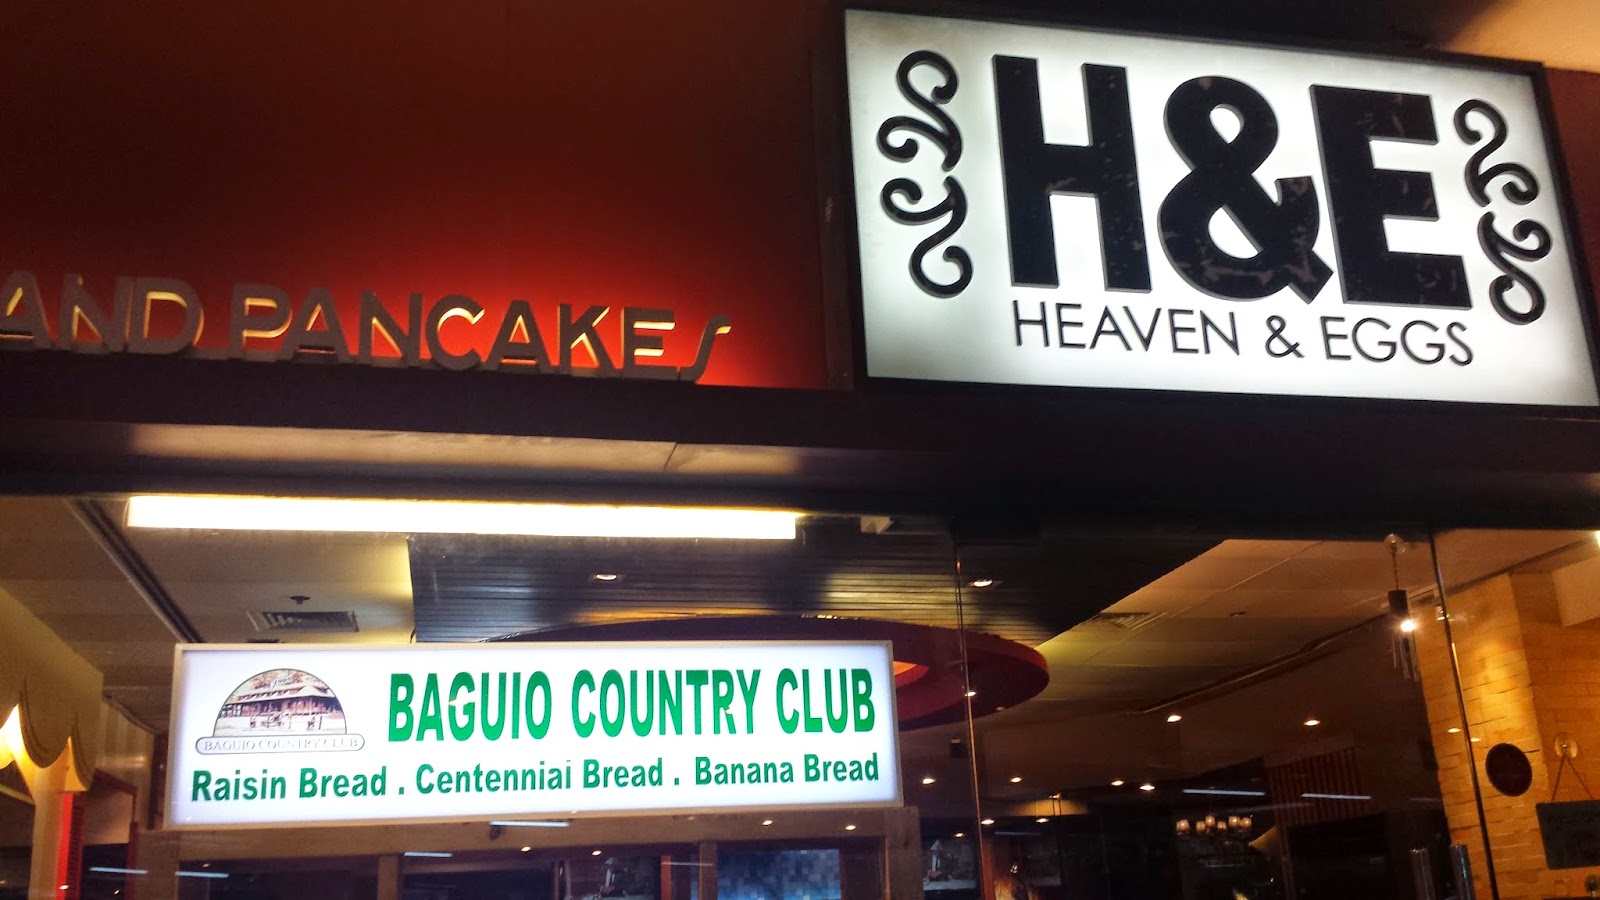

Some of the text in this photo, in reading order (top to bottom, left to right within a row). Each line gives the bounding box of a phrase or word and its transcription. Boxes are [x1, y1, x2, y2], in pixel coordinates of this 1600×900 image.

[992, 54, 1472, 310] H&E
[0, 271, 732, 383] AND PANCAKES
[1013, 300, 1474, 366] HEAVEN & EGGS
[388, 668, 876, 742] BAGUIO COUNTRY CLUB
[191, 769, 286, 802] Raisin
[299, 766, 388, 798] Bread
[583, 758, 663, 788] Bread
[695, 756, 794, 785] Banana
[804, 752, 879, 783] Bread
[204, 736, 358, 751] BAGUIO COUNTRY CLUB
